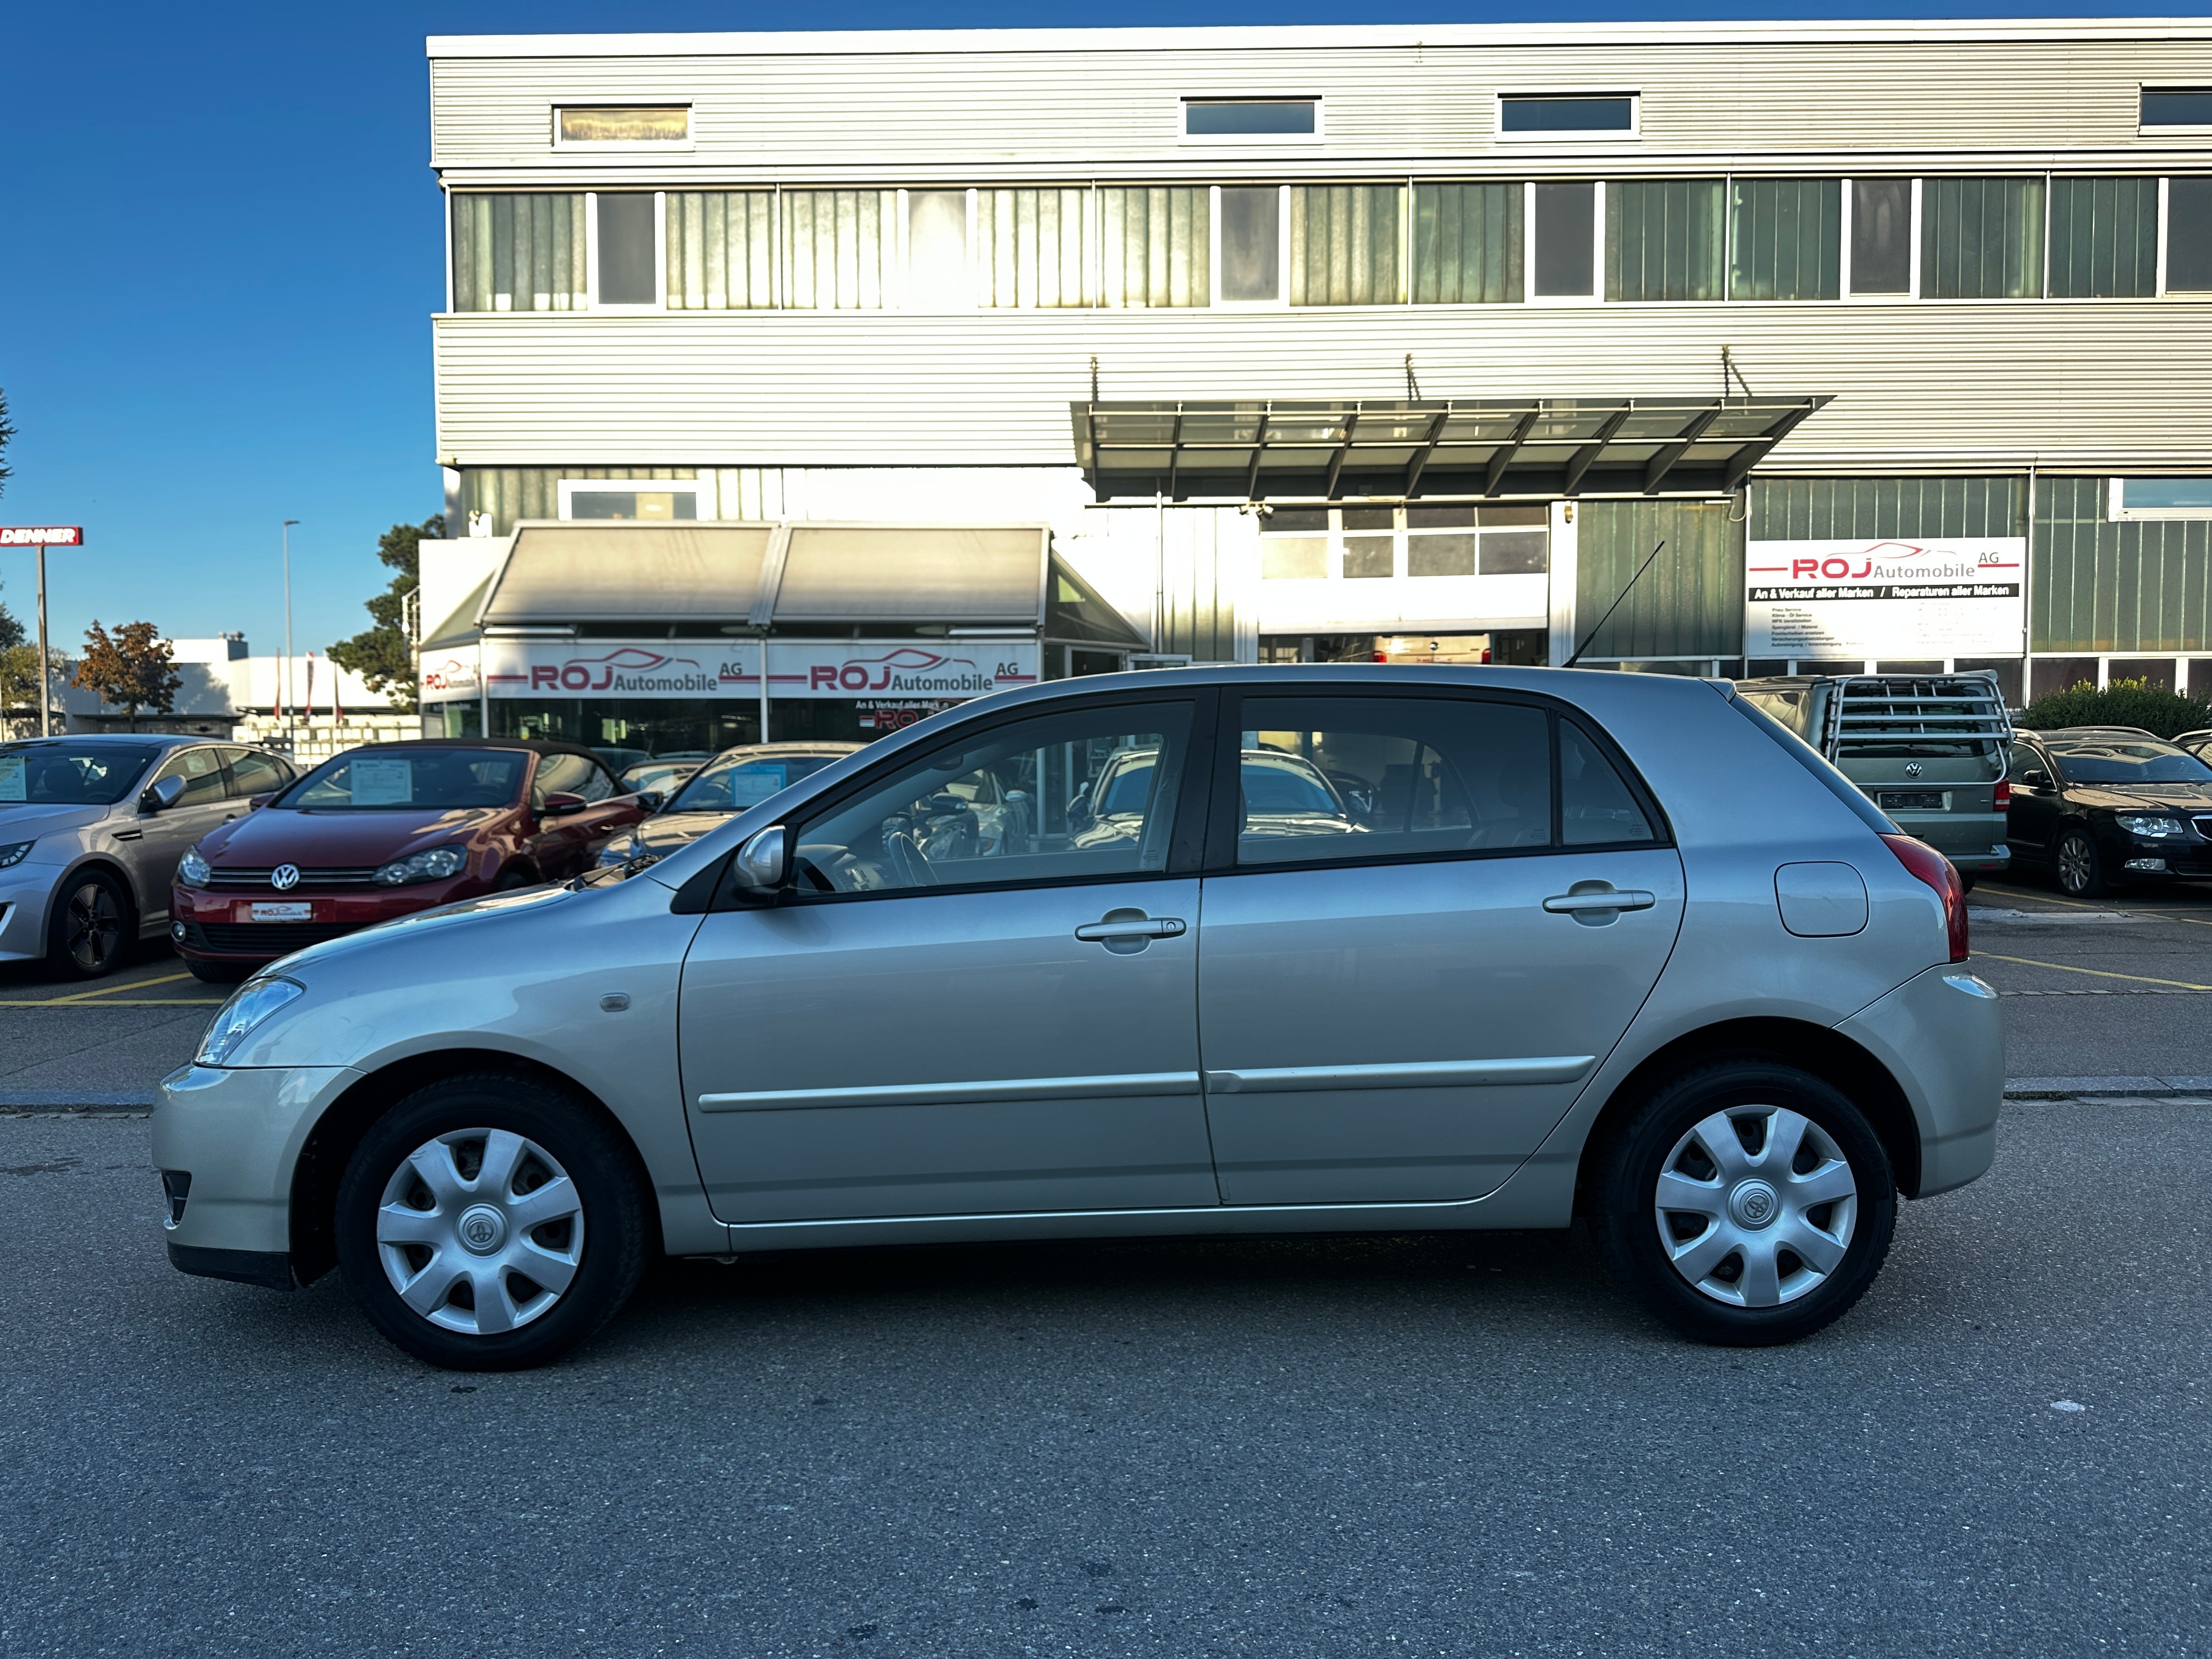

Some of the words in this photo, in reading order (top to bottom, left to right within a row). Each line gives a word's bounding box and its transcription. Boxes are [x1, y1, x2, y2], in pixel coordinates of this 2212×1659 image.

[0, 528, 76, 544] DENNER
[1792, 558, 1872, 579] ROJ
[1874, 563, 1975, 578] Automobile
[1978, 552, 1999, 563] AG
[1754, 589, 1768, 599] An
[1769, 589, 1778, 599] &
[1779, 587, 1815, 599] Verkauf
[1815, 587, 1837, 598] aller
[1838, 587, 1874, 598] Marken
[1892, 586, 1950, 599] Reparaturen
[1951, 585, 1972, 596] aller
[1974, 585, 2009, 596] Marken
[531, 665, 613, 690] ROJ
[613, 674, 718, 691] Automobile
[720, 662, 743, 675] AG
[810, 665, 891, 690] ROJ
[891, 674, 994, 691] Automobile
[996, 662, 1019, 675] AG
[855, 700, 867, 709] An
[868, 700, 875, 709] &
[272, 865, 299, 889] VW
